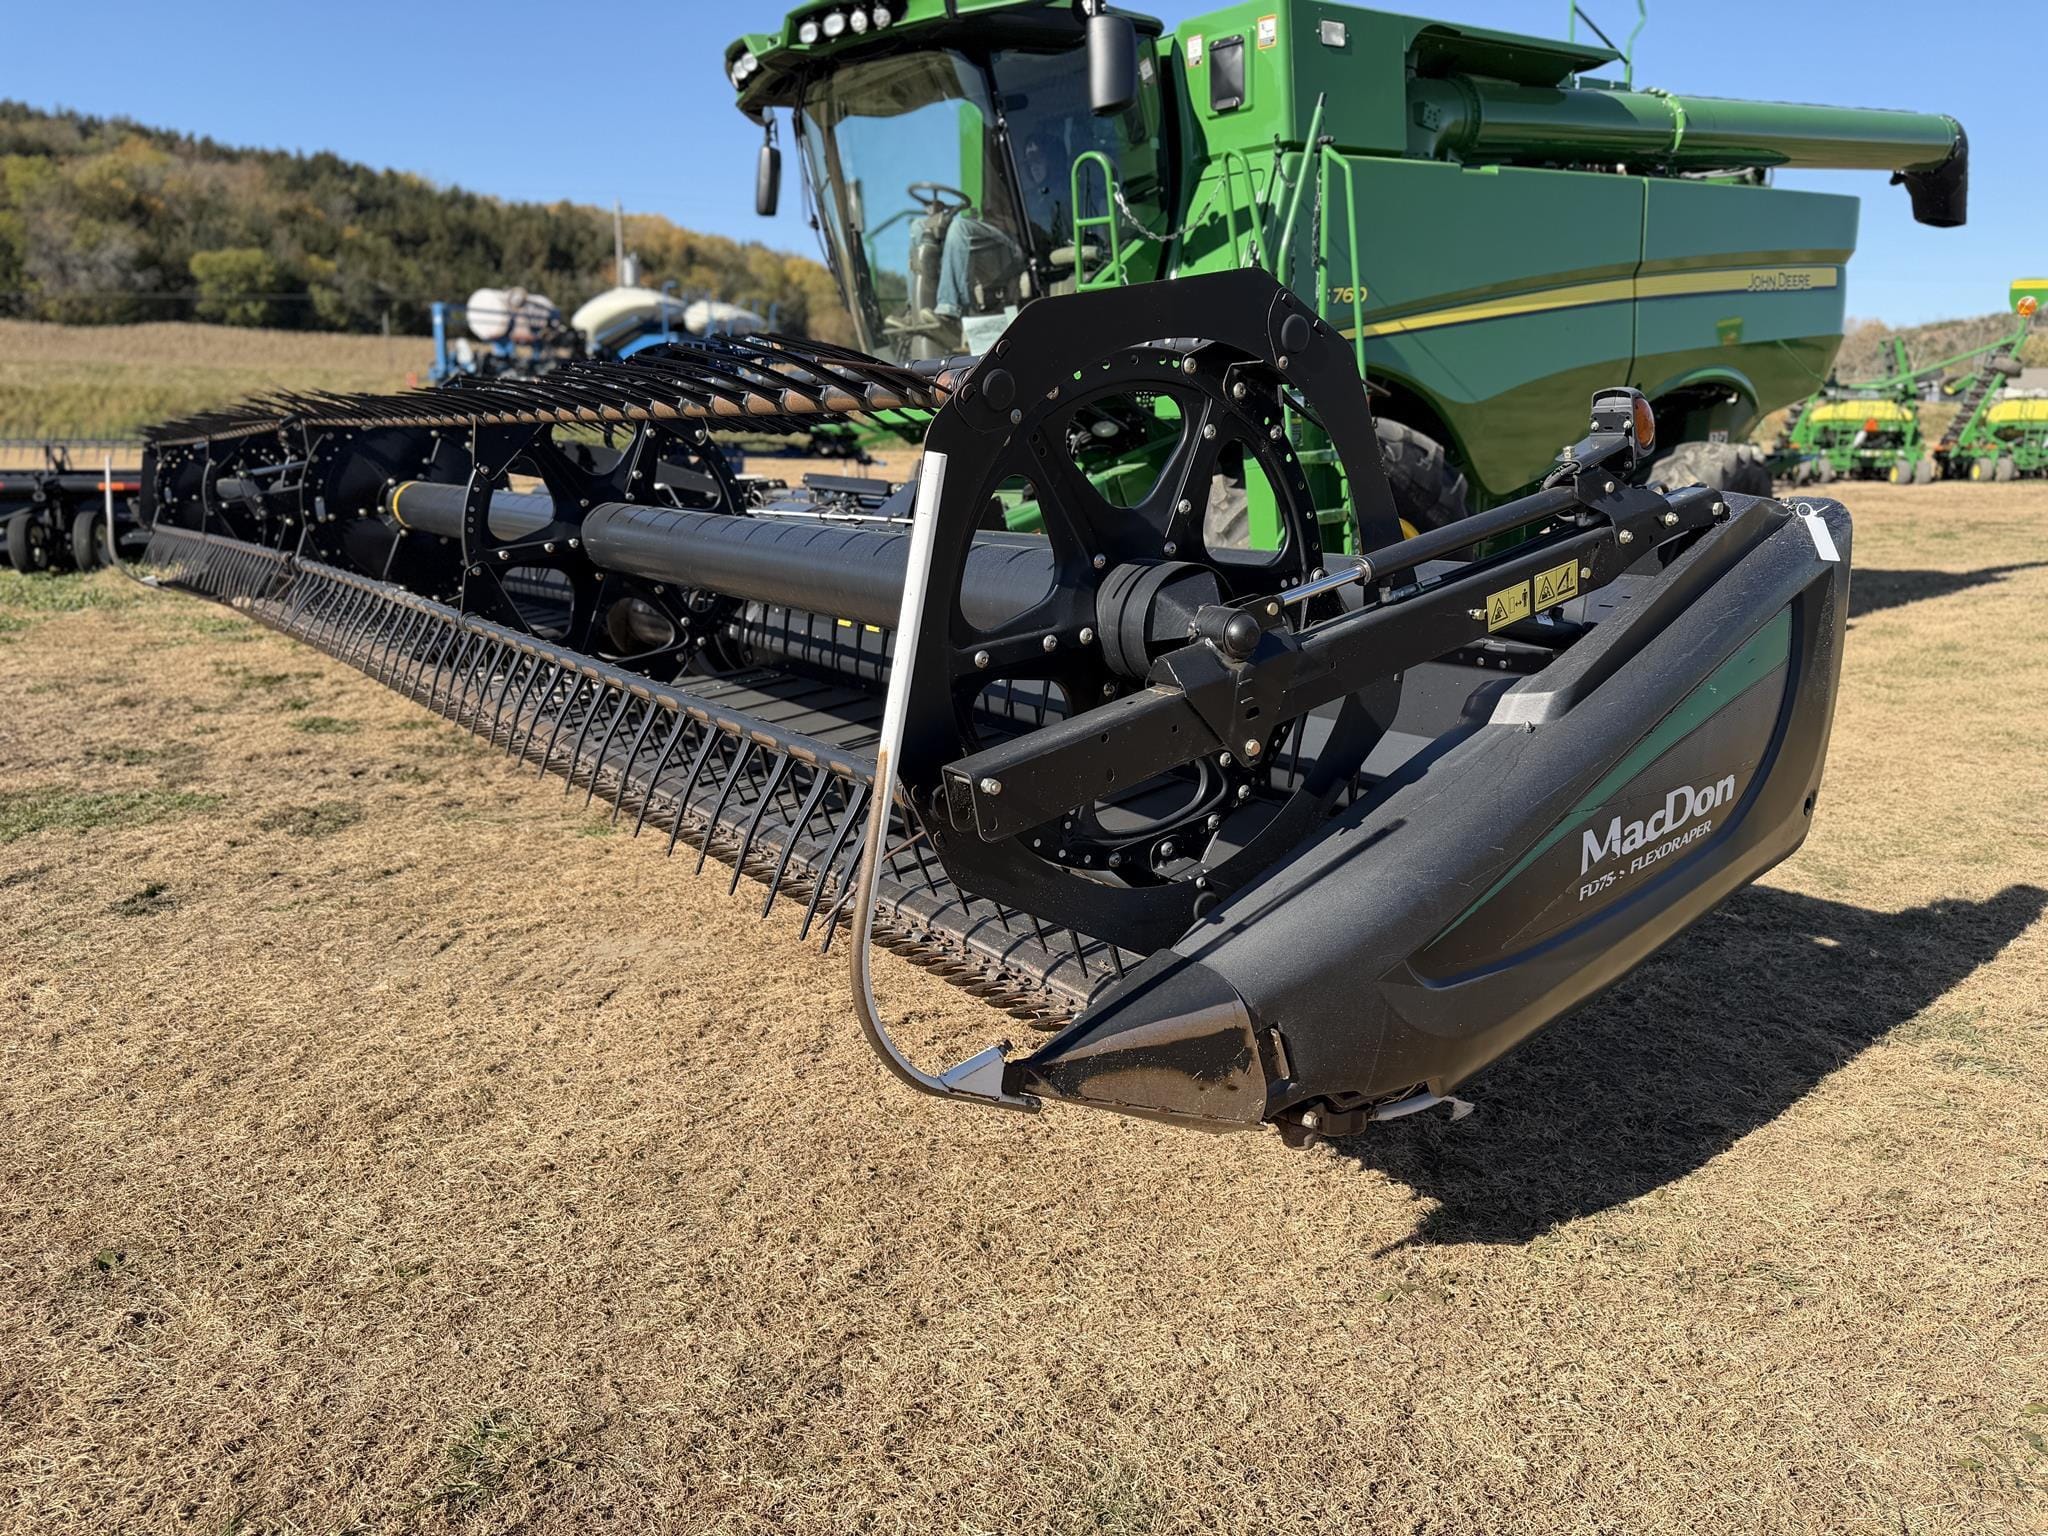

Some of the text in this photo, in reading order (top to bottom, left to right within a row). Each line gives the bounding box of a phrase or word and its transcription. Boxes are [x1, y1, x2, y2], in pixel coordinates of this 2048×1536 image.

[1747, 271, 1812, 291] JOHN DEERE
[1581, 774, 1736, 876] MacDon
[1630, 820, 1712, 874] FLEXDRAPER
